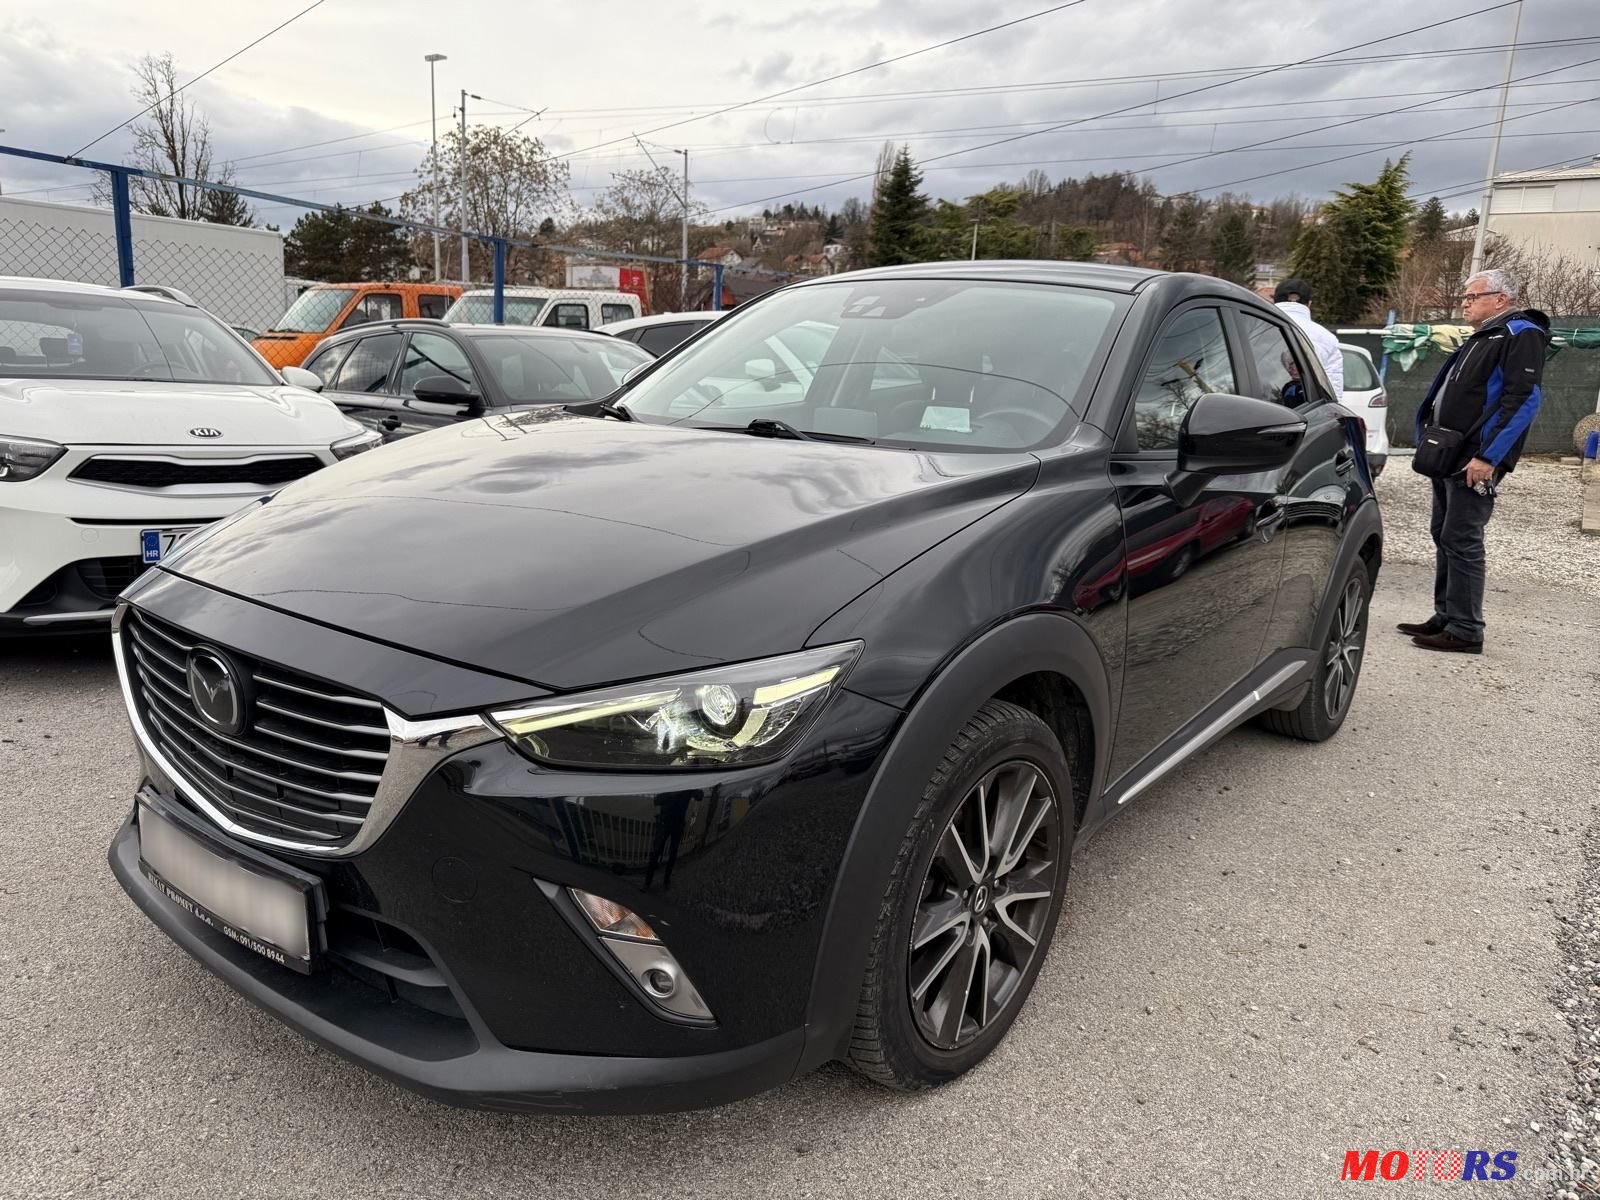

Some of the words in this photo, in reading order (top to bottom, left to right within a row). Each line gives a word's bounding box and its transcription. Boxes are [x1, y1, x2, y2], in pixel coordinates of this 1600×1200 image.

[194, 428, 219, 436] KIA
[146, 550, 159, 558] HR
[223, 926, 239, 942] GSM:
[240, 936, 266, 955] 091/500
[267, 948, 285, 963] 8944
